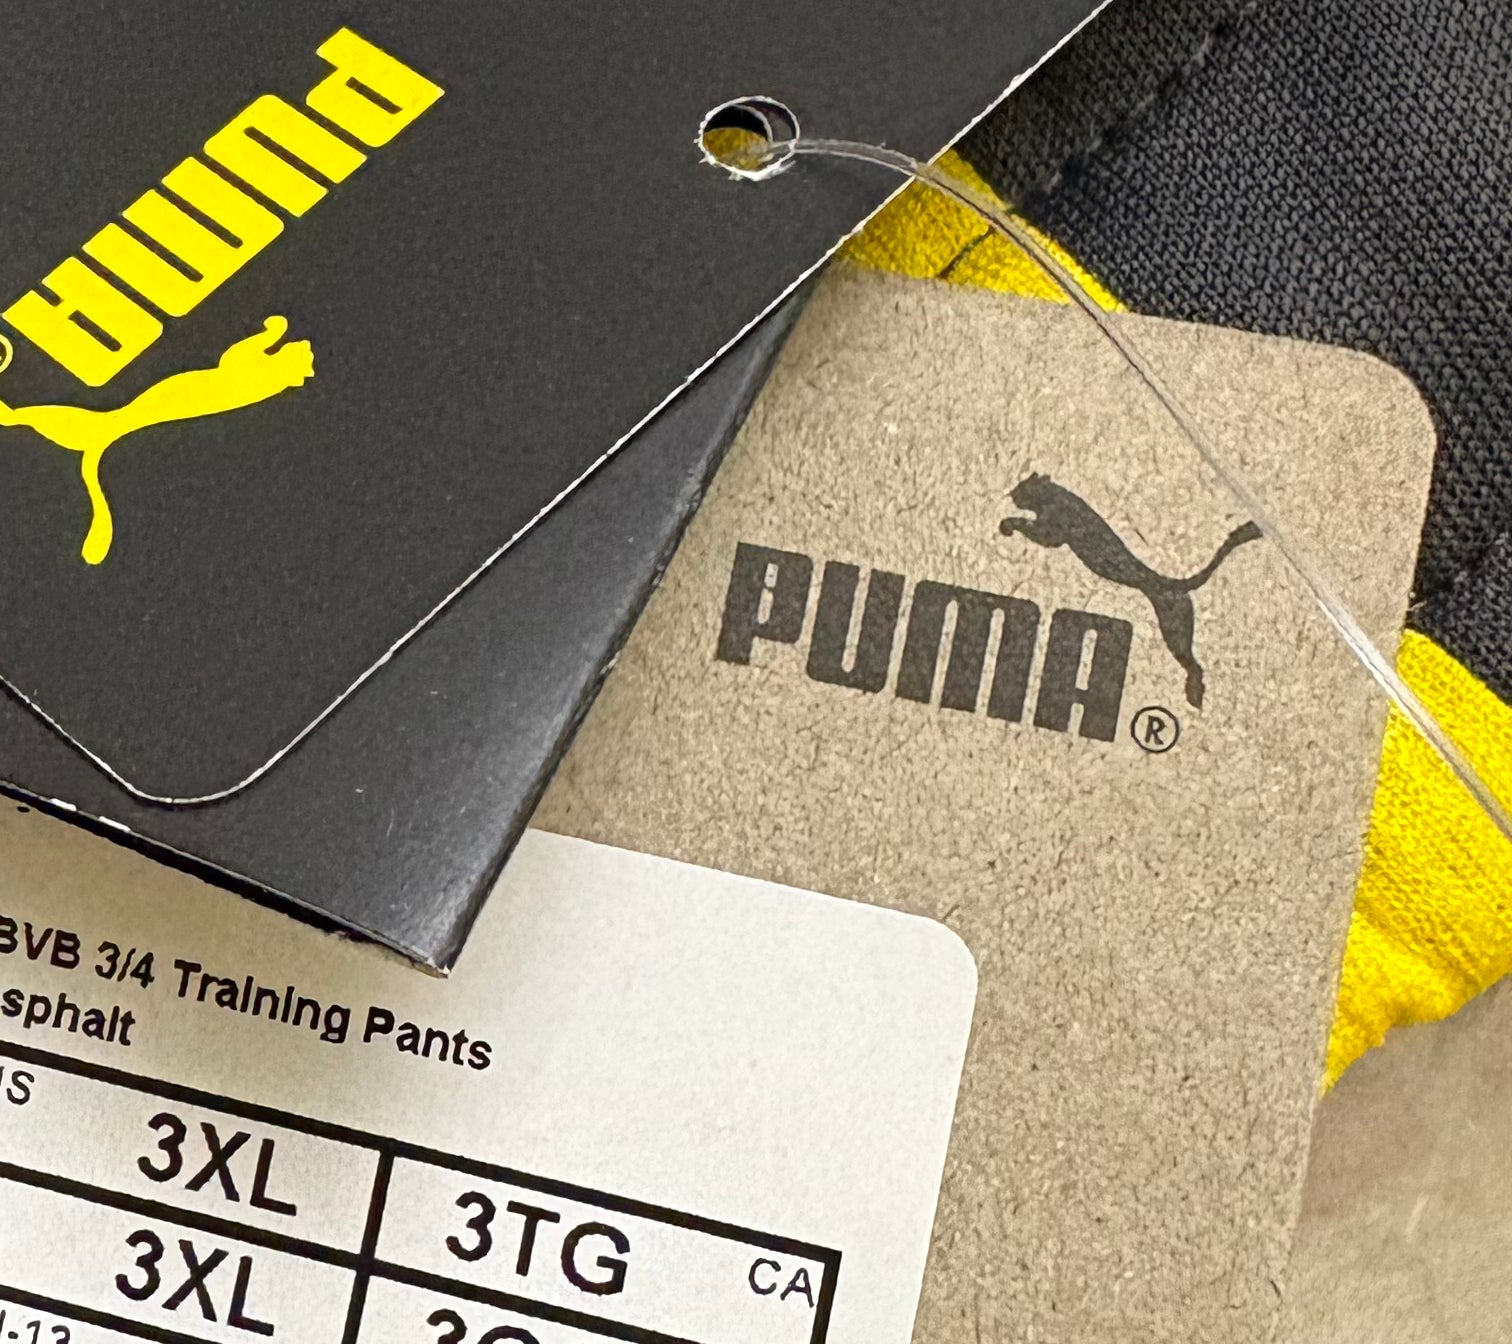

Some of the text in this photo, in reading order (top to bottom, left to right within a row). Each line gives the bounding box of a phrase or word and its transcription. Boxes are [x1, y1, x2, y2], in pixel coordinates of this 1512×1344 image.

[95, 941, 154, 989] 3/4
[173, 960, 350, 1043] Training
[363, 1008, 492, 1070] Pants
[137, 1112, 297, 1217] 3XL
[115, 1229, 274, 1337] 3XL
[445, 1191, 630, 1297] 3TG
[748, 1258, 817, 1307] CA
